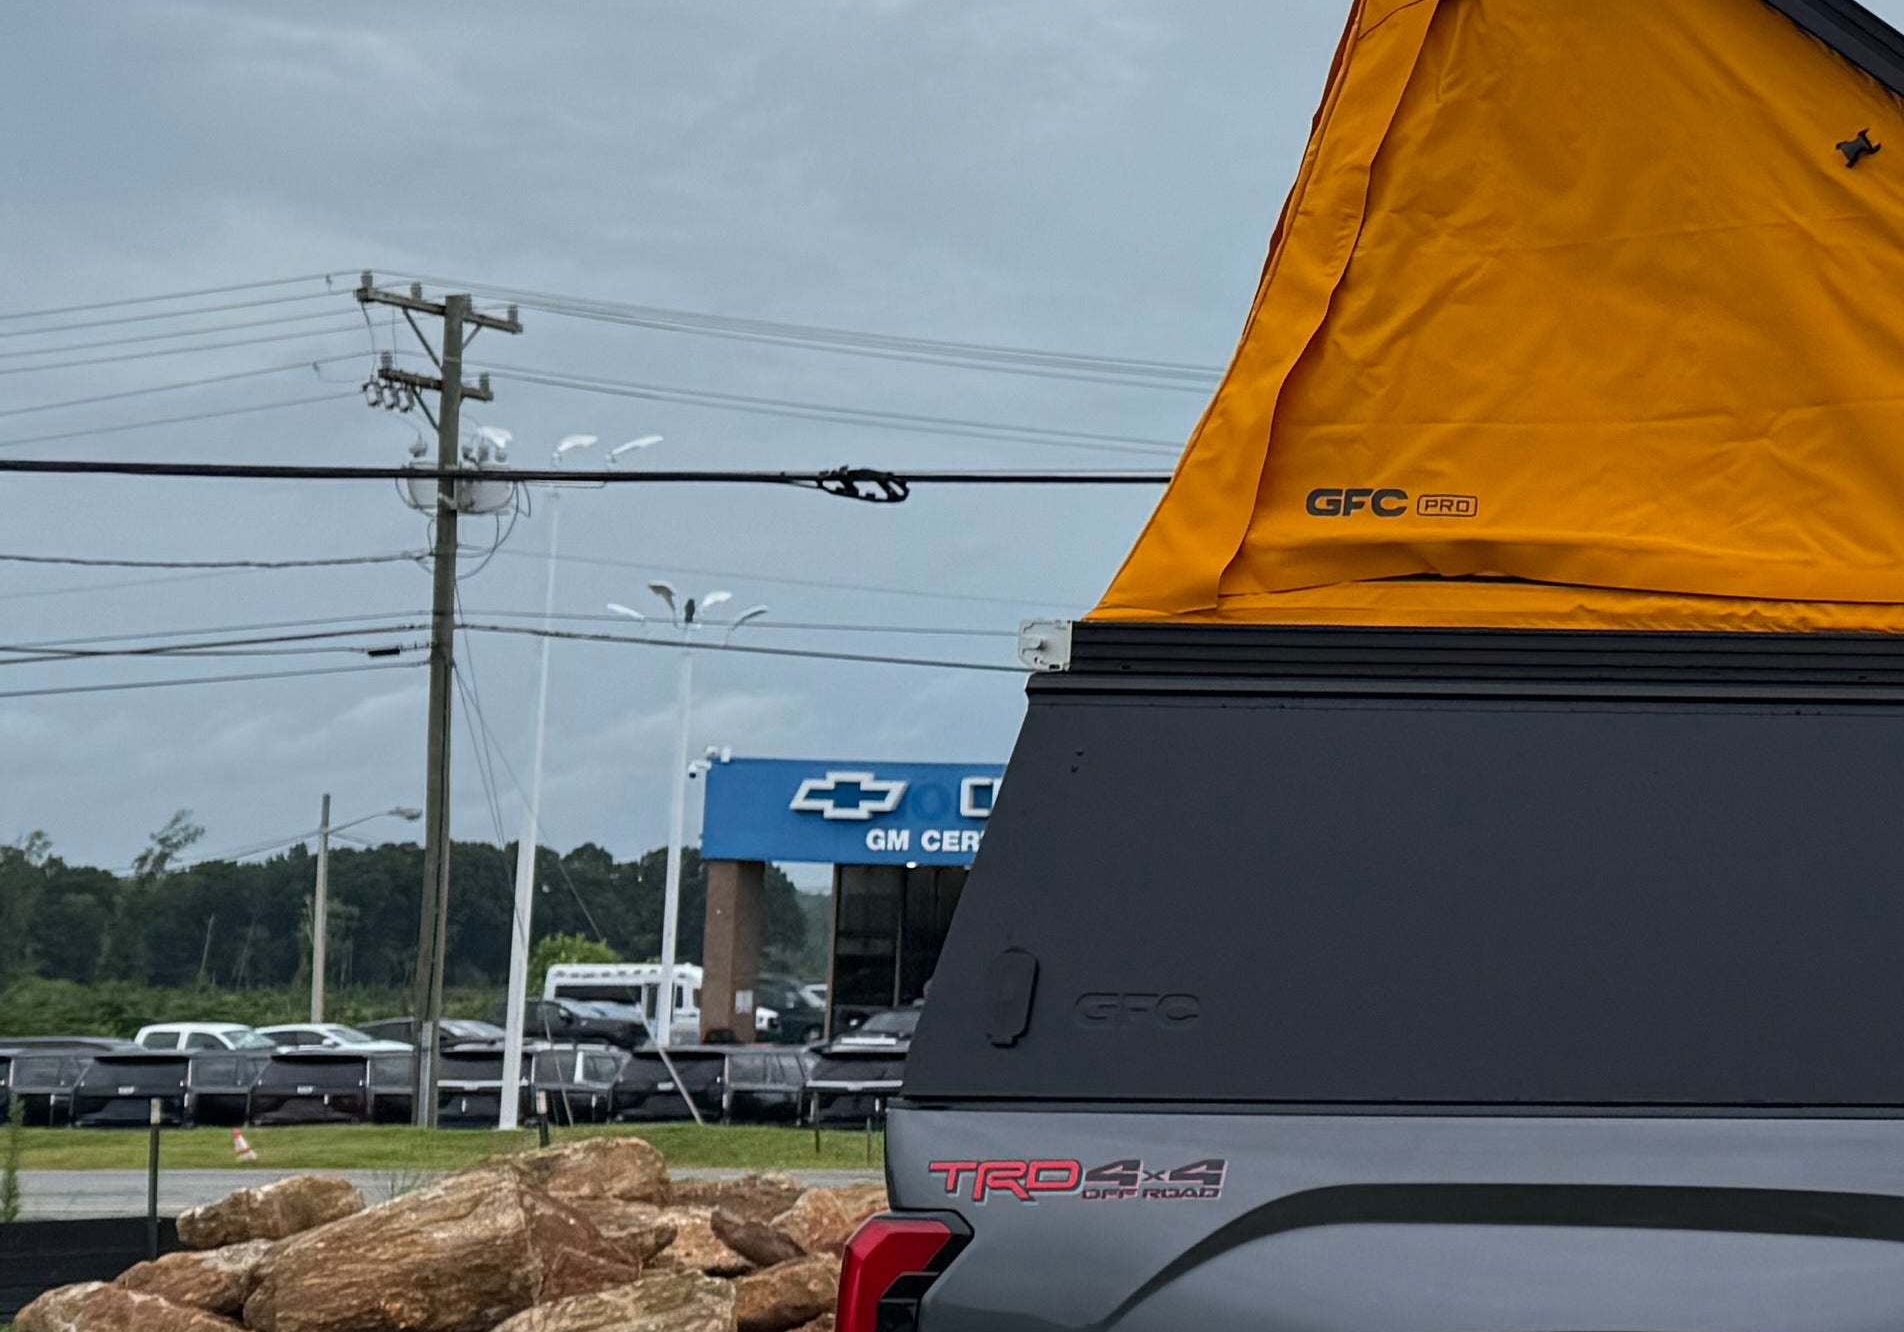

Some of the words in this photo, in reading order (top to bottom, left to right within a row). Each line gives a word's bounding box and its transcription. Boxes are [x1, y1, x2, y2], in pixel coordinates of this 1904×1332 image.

[1306, 488, 1408, 517] GFC
[1423, 498, 1470, 513] PRO
[866, 828, 910, 852] GM
[921, 829, 985, 853] CER
[1075, 991, 1200, 1029] GFC
[929, 1159, 1085, 1205] TRD
[1082, 1187, 1138, 1201] OFF
[1141, 1187, 1222, 1201] ROAD
